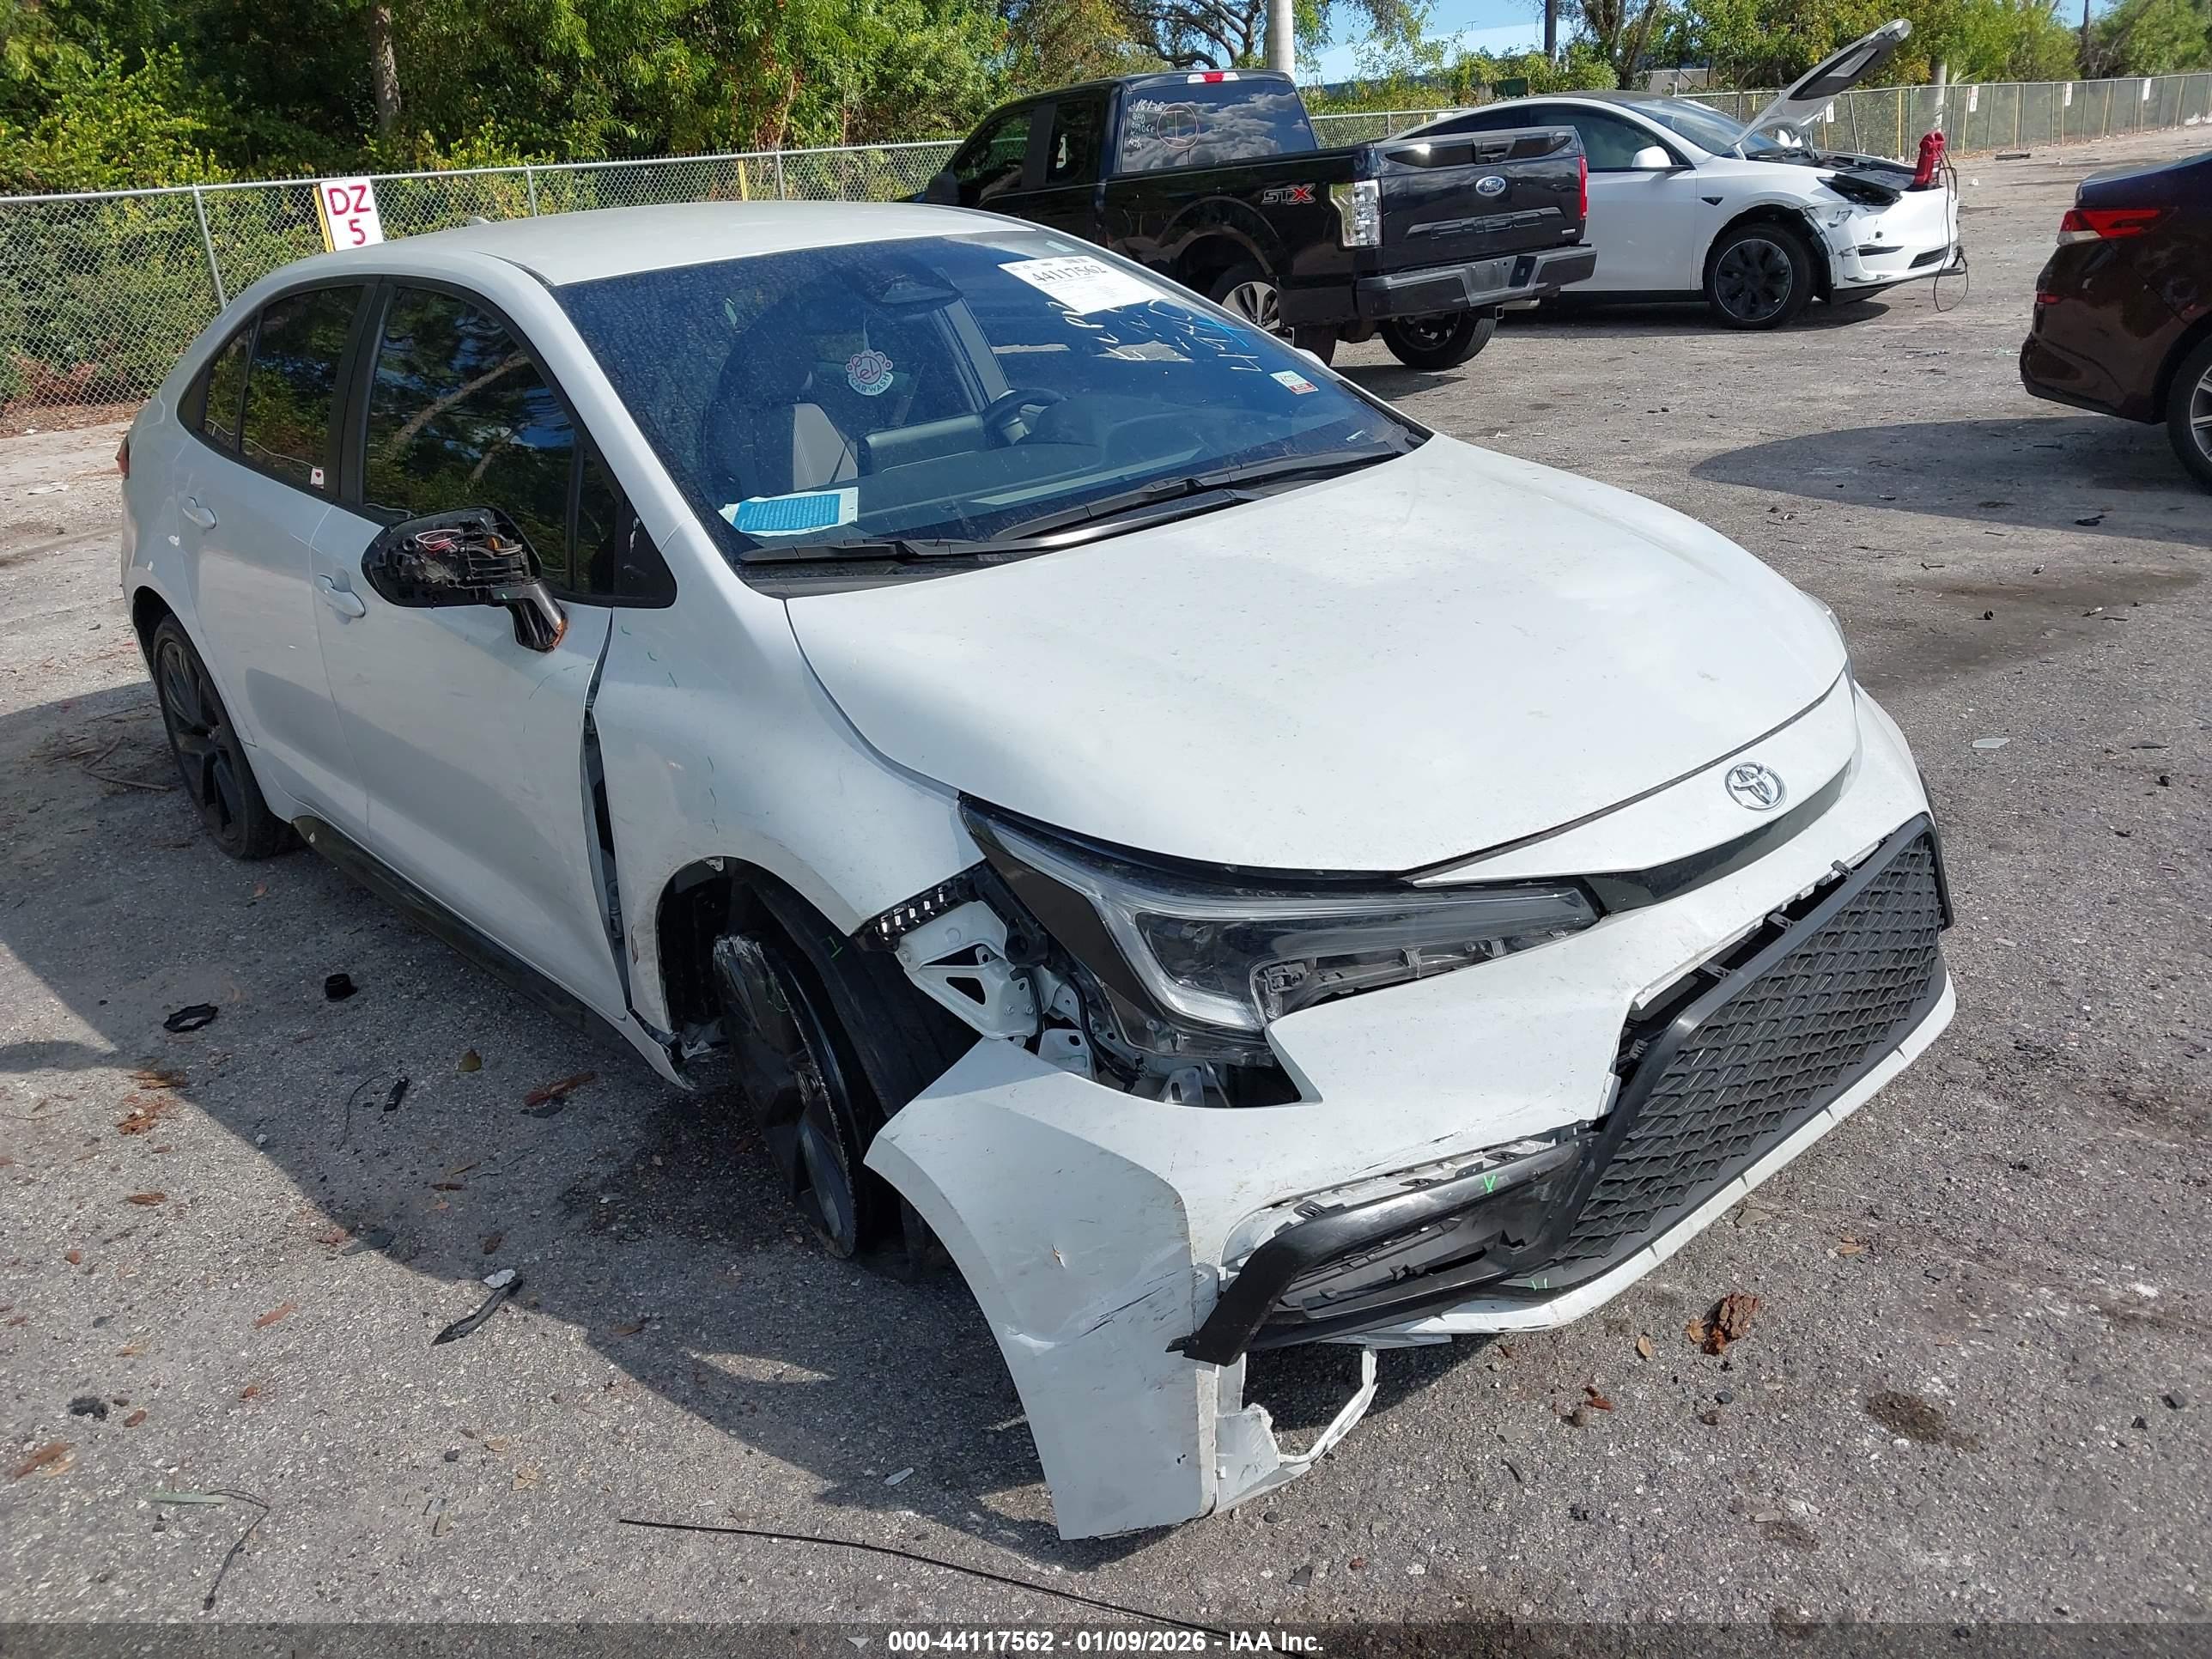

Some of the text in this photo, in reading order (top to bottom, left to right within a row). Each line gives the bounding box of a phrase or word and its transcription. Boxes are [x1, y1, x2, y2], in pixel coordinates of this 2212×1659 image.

[326, 185, 372, 216] DZ
[1261, 183, 1316, 205] STX
[347, 218, 366, 246] 5
[1031, 264, 1109, 283] 44117562
